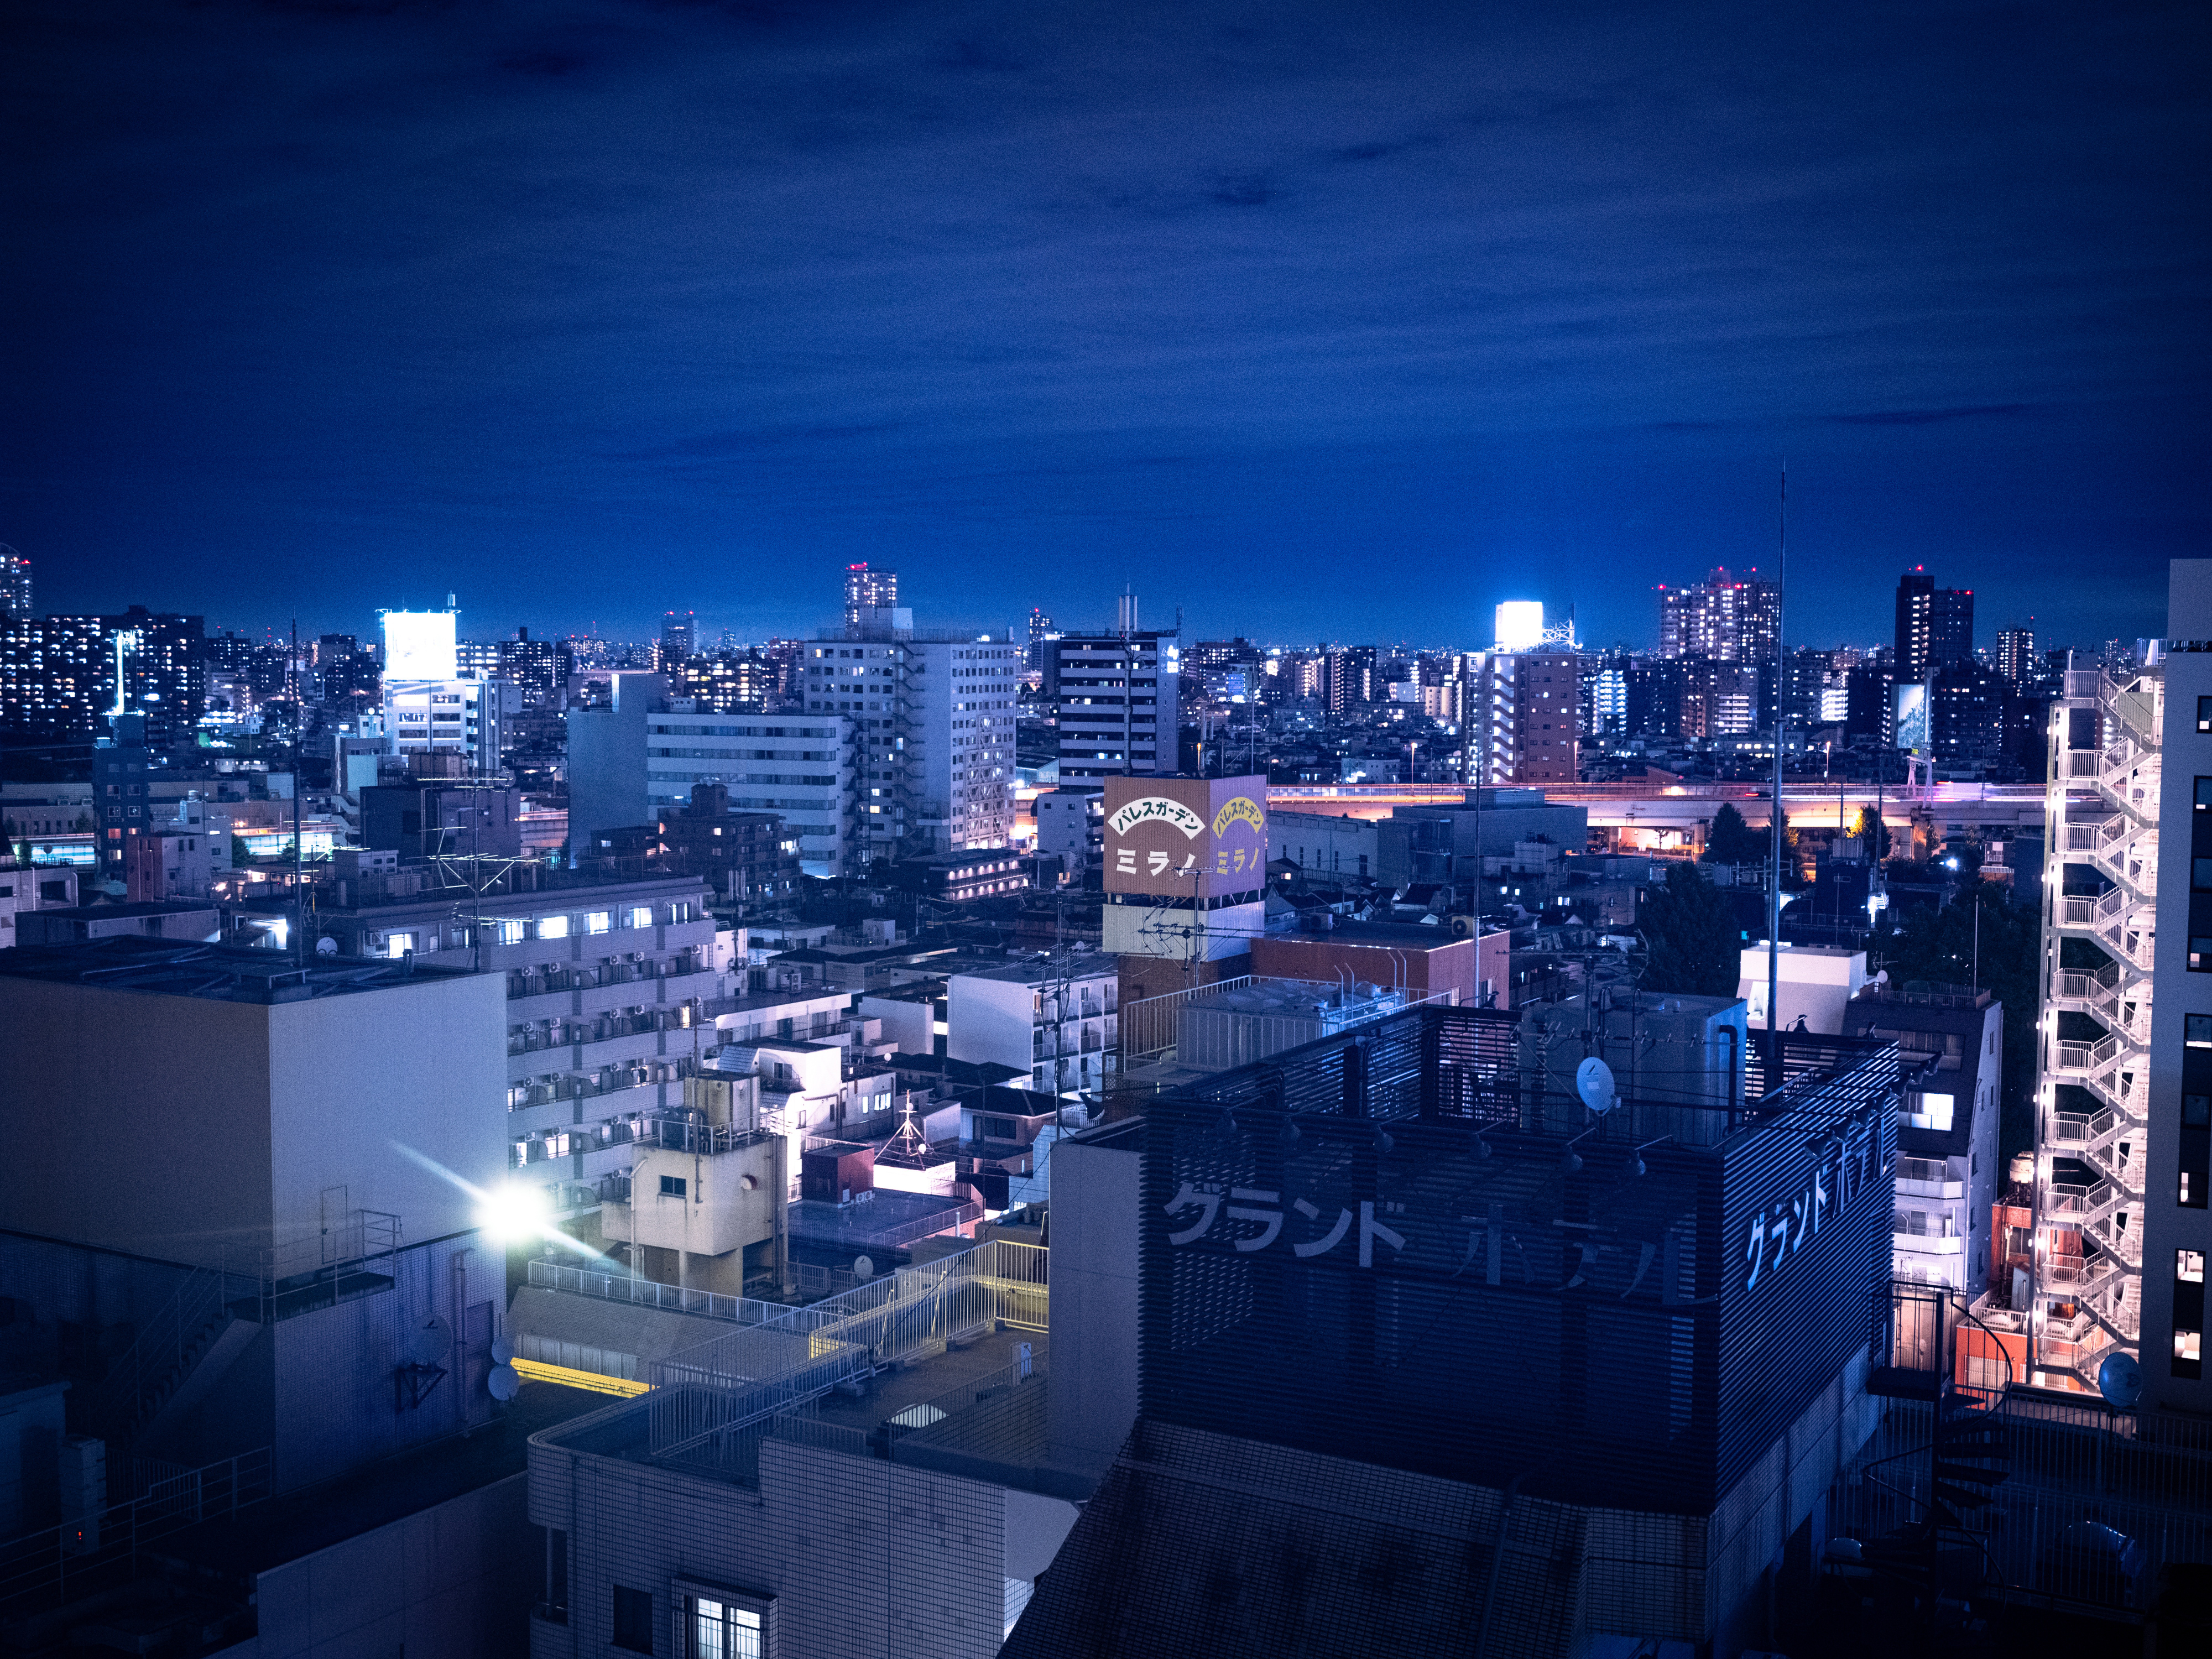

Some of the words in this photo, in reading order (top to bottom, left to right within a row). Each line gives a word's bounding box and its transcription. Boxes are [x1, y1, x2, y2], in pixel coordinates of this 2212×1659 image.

[1118, 801, 1198, 831] パレスガーデン
[1217, 800, 1261, 834] パレスガーデン
[1116, 848, 1196, 877] ミラノ
[1217, 847, 1259, 875] ミラノ
